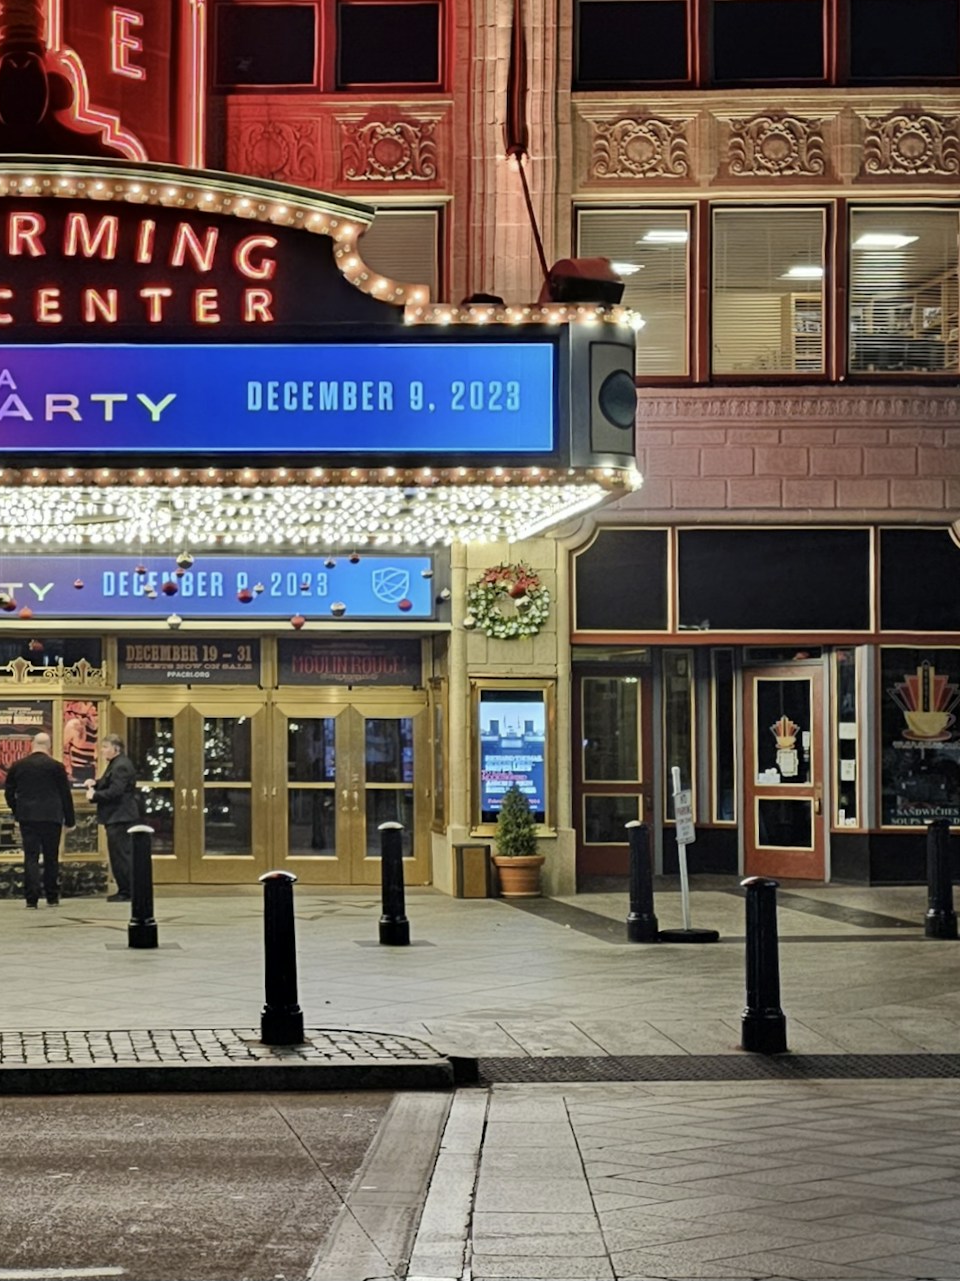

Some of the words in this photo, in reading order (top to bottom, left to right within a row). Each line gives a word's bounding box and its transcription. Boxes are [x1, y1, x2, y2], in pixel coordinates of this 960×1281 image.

[246, 380, 394, 412] DECEMBER
[409, 380, 436, 413] 9,
[450, 380, 521, 412] 2023
[270, 571, 328, 597] 2023
[126, 644, 198, 662] DECEMBER
[202, 644, 218, 662] 19
[237, 644, 253, 661] 31
[292, 655, 347, 673] MOULIN
